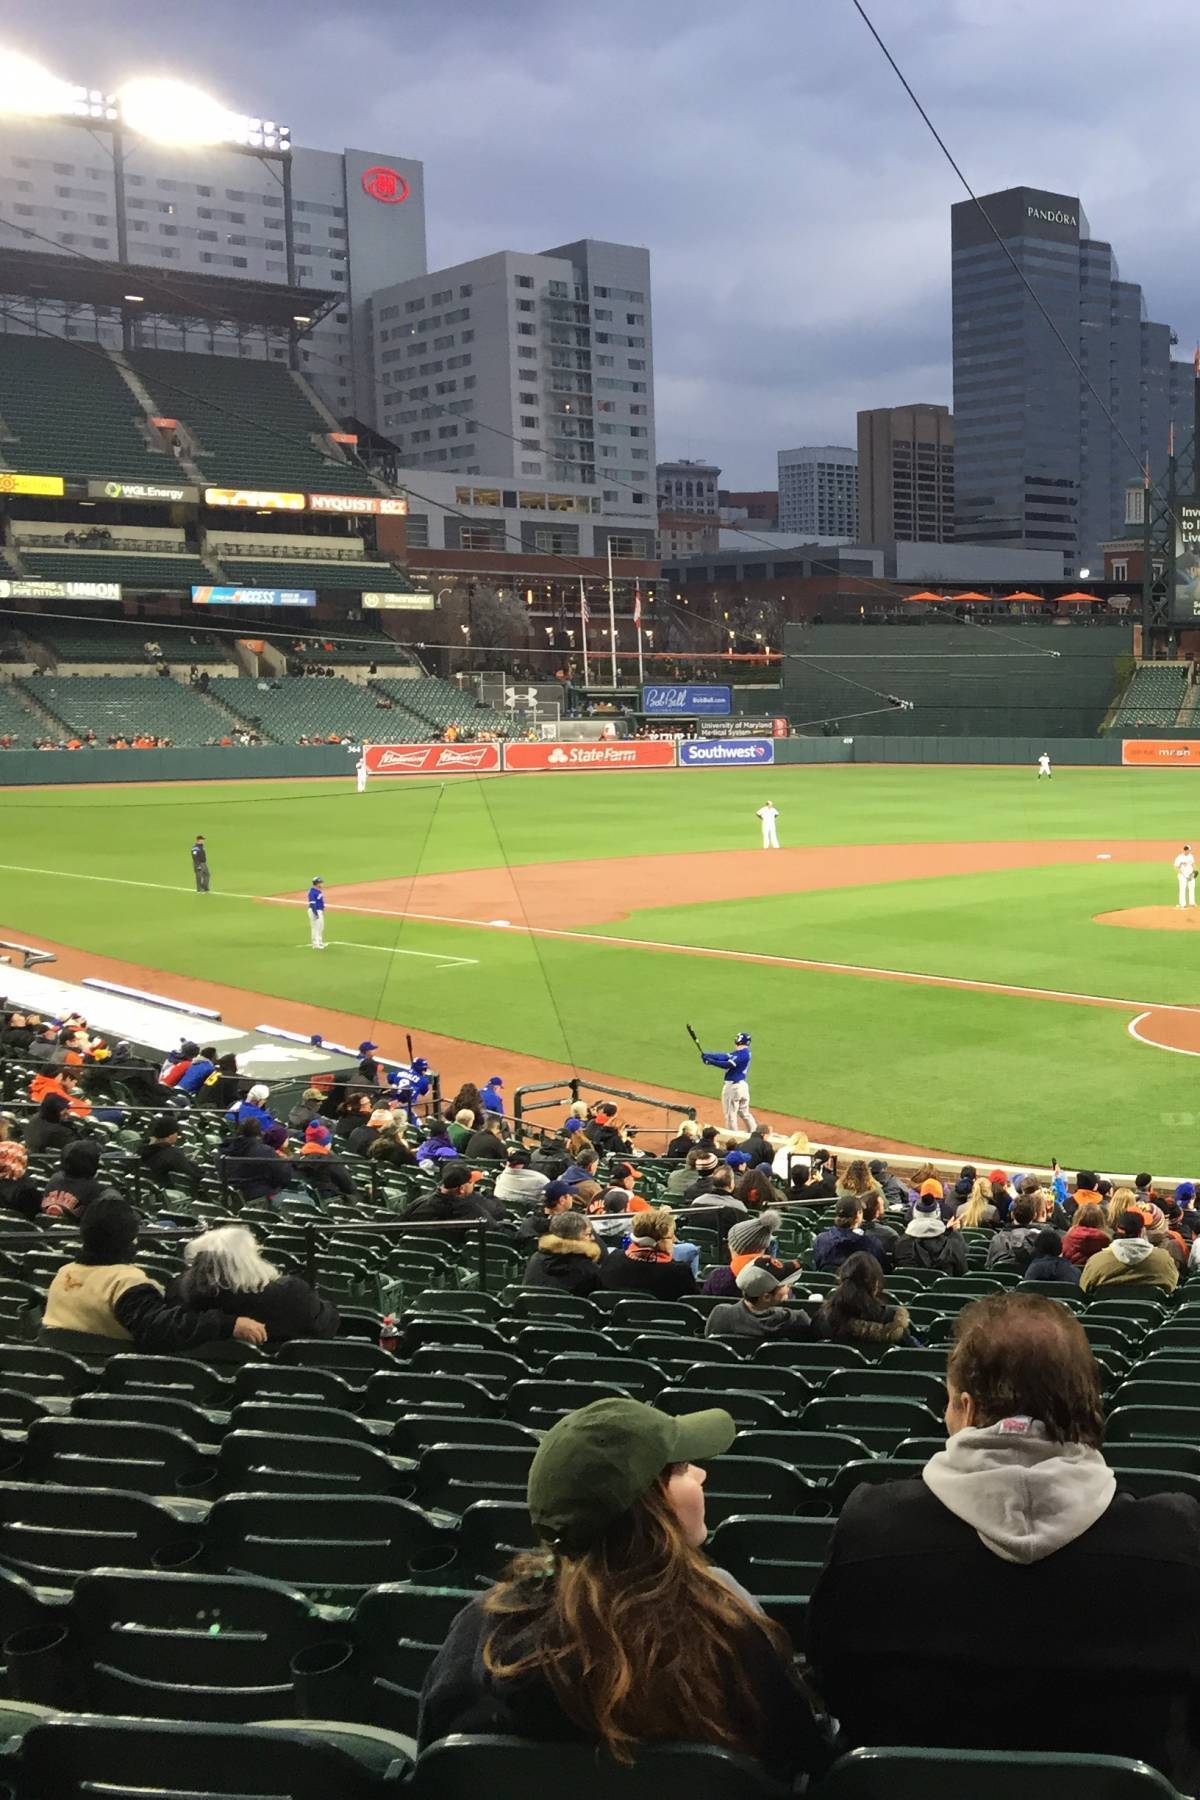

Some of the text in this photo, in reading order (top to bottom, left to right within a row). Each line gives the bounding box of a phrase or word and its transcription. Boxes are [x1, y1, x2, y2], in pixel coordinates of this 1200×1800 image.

[1028, 206, 1077, 226] PANDORA
[122, 485, 184, 501] WGL Energy
[1182, 520, 1194, 530] to
[66, 582, 120, 599] UNION
[701, 721, 733, 731] University
[744, 722, 773, 731] Maryland
[727, 729, 752, 737] System
[689, 745, 756, 759] Southwest
